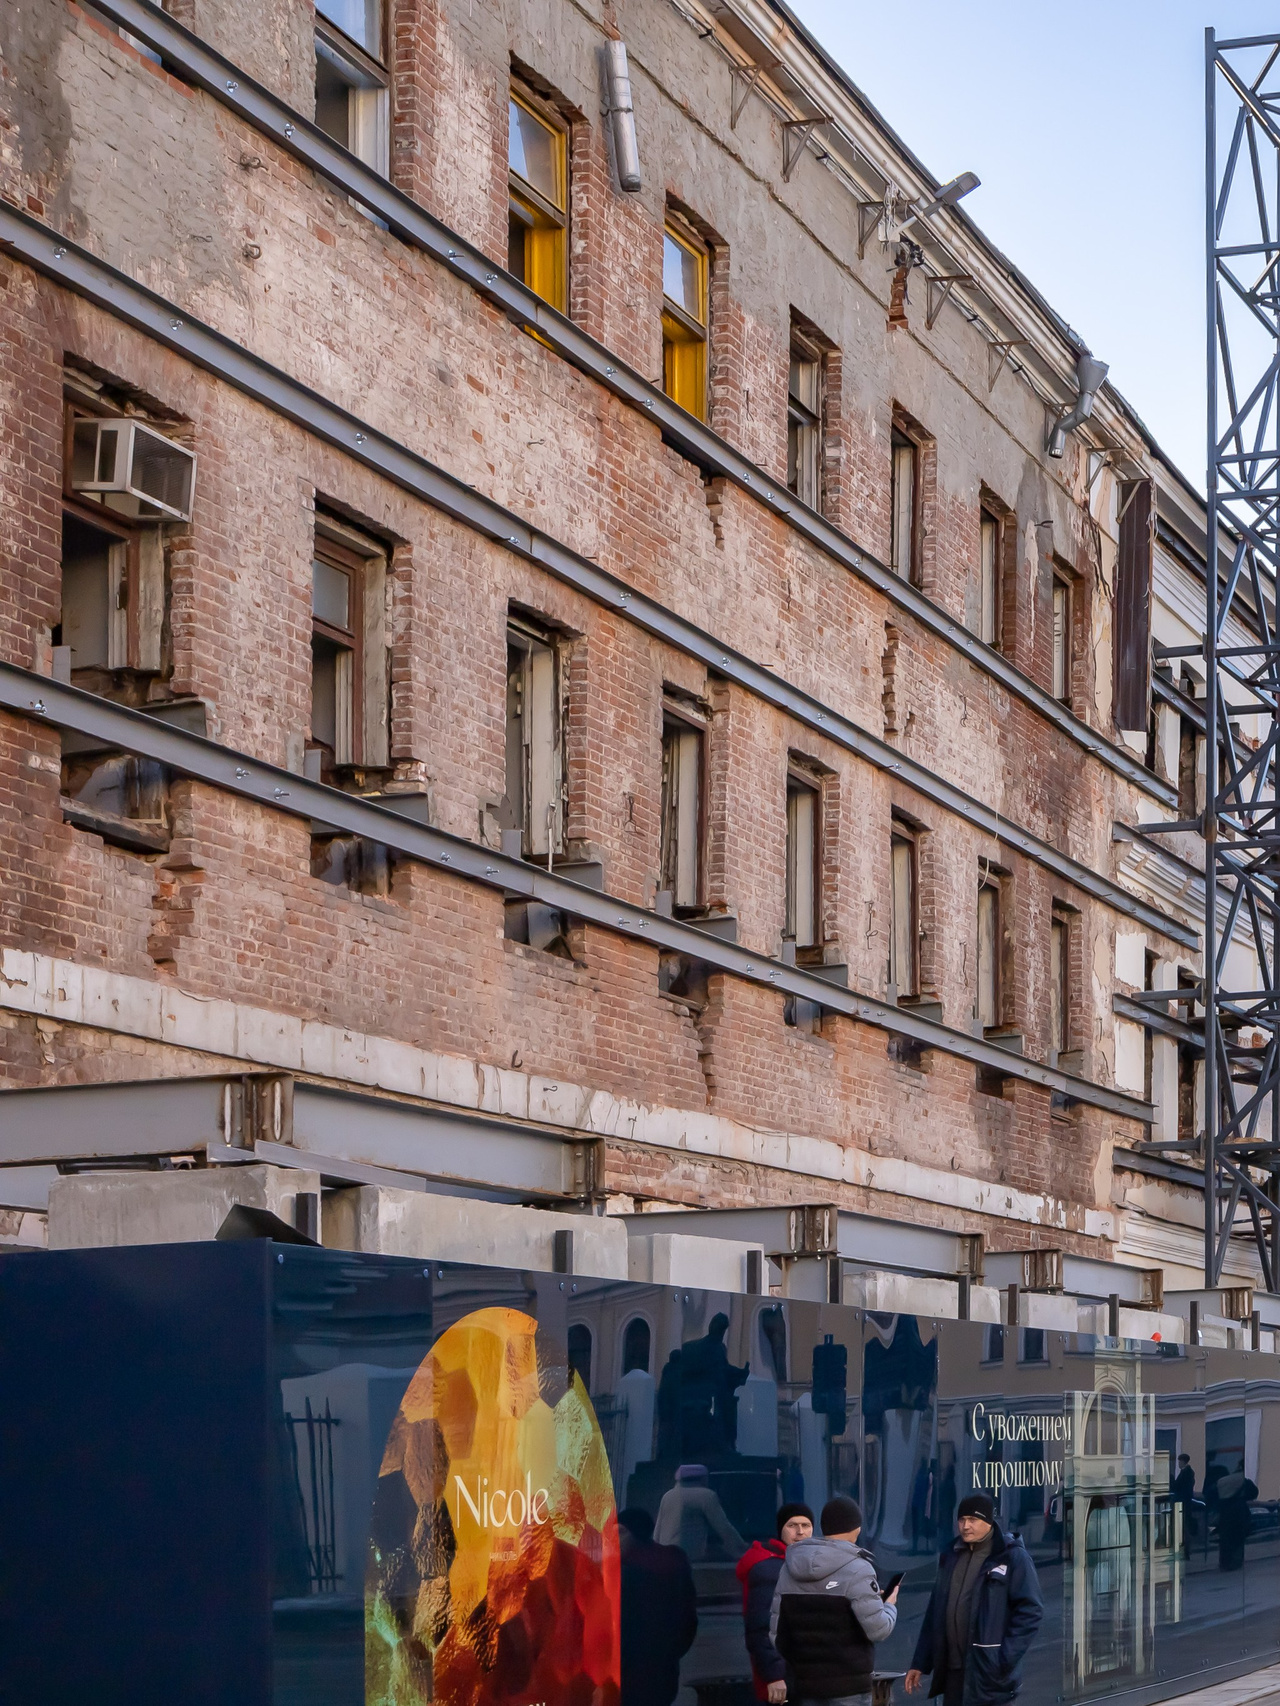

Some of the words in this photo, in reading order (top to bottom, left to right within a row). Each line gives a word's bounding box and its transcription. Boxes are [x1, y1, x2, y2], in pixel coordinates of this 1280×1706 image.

[971, 1402, 985, 1442] С
[989, 1414, 1072, 1450] уважением
[453, 1470, 550, 1529] Nicole
[972, 1461, 982, 1489] к
[985, 1460, 1063, 1498] прошлому
